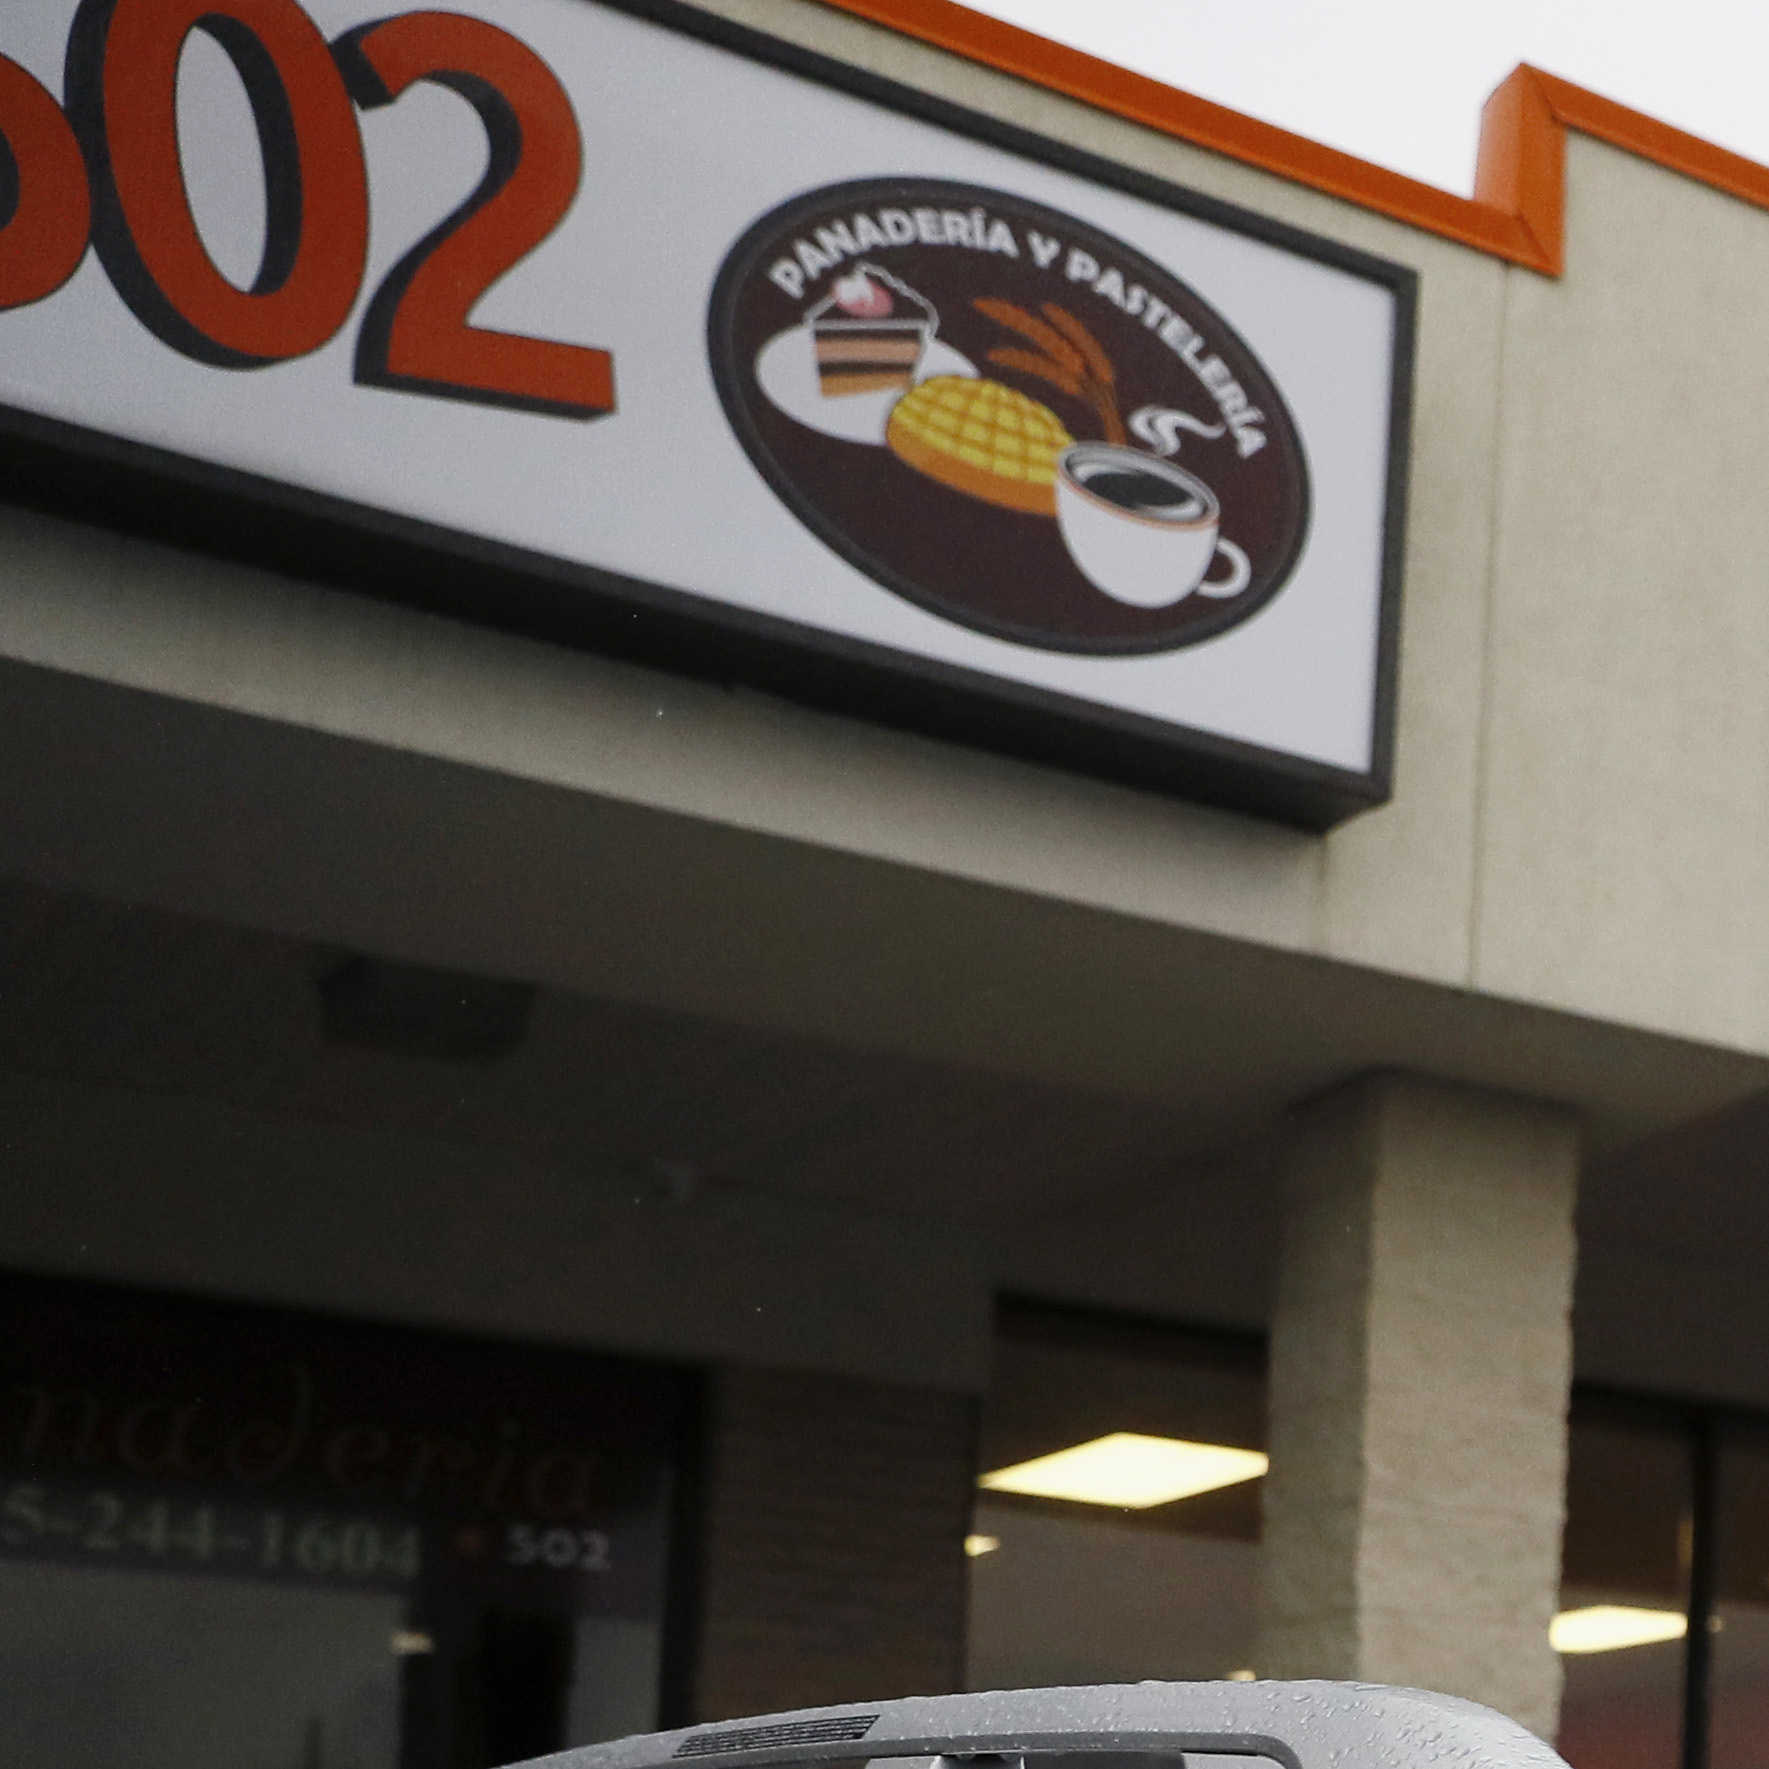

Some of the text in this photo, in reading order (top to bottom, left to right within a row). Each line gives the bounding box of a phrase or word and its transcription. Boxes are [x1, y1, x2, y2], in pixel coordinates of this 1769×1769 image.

[768, 206, 1267, 459] PANADERÍA Y PASTELERÍA
